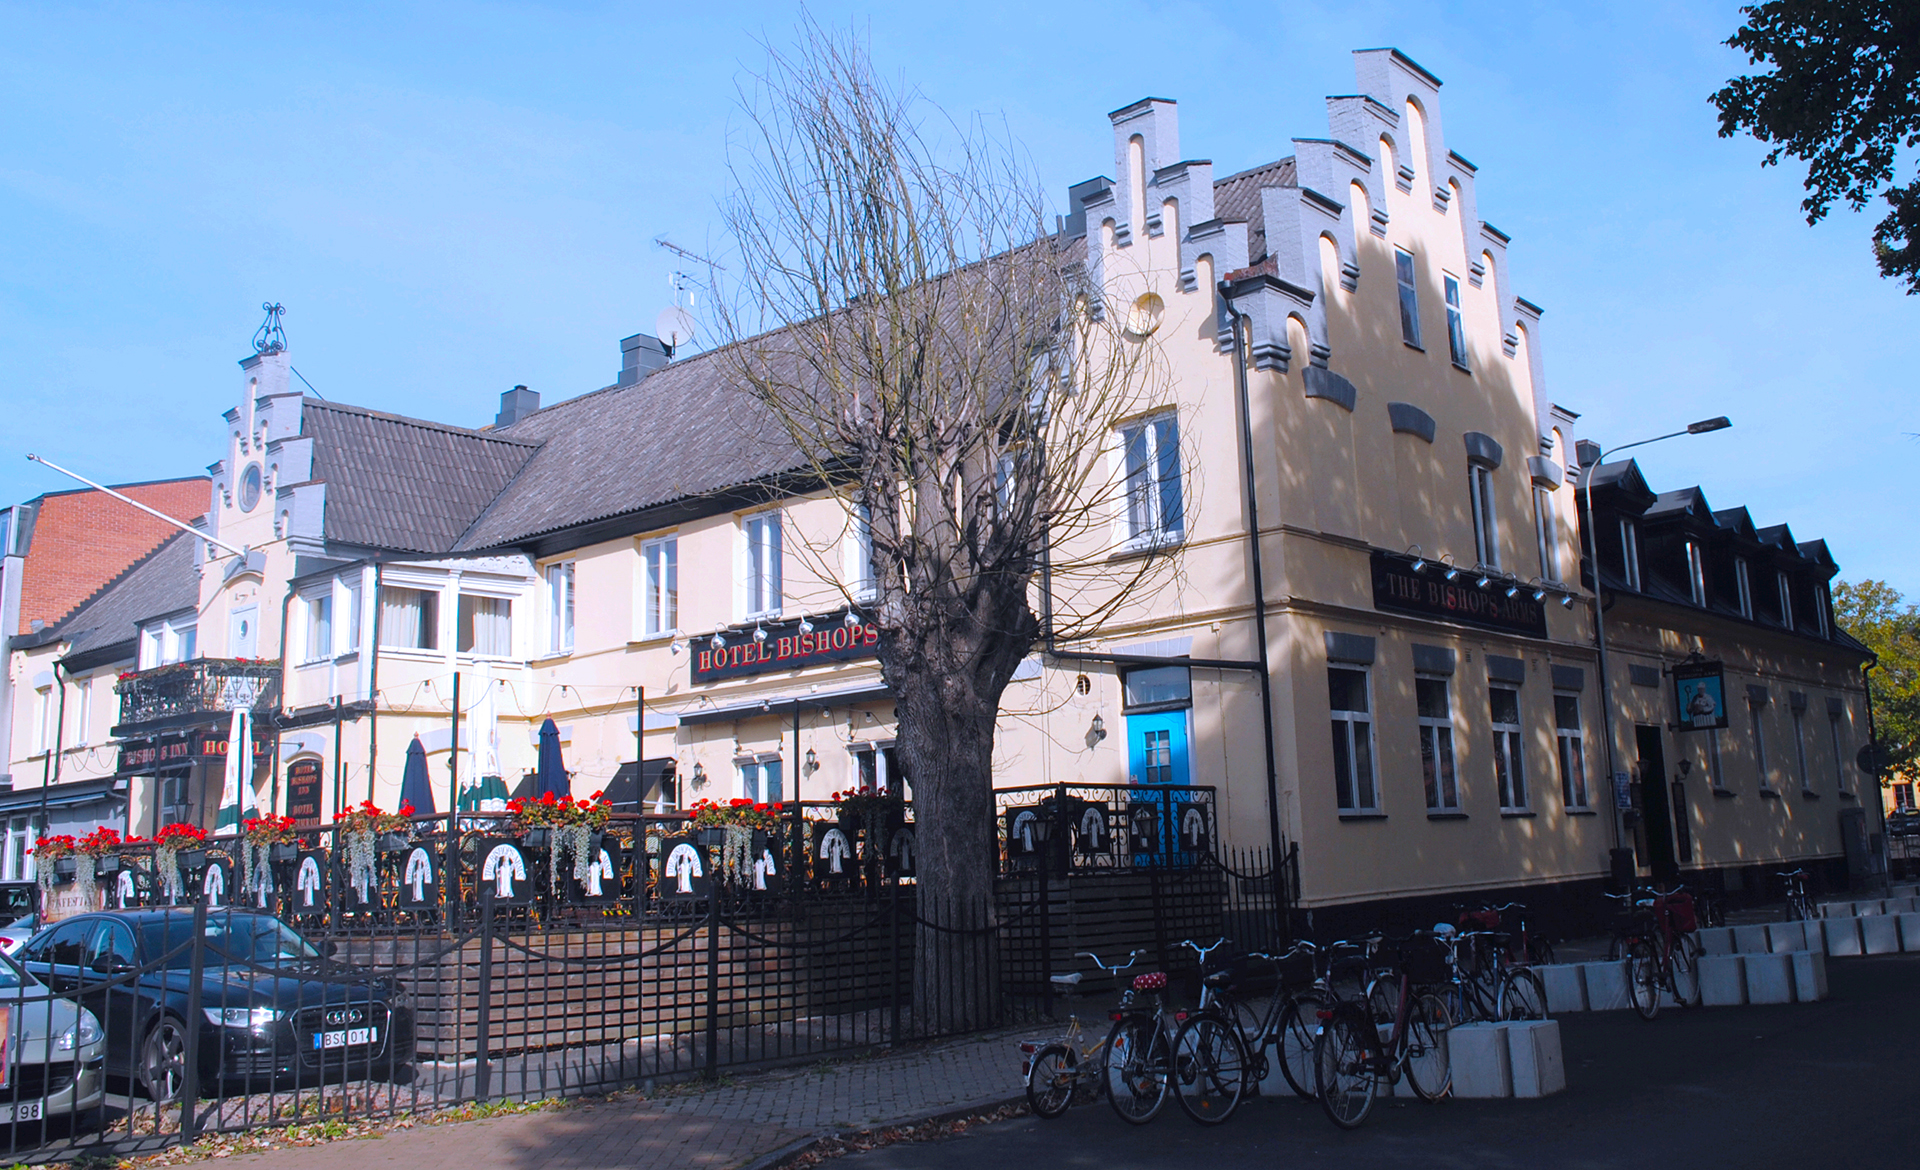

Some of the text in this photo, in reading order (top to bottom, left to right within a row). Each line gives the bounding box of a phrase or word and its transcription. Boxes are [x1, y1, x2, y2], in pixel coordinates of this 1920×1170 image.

[1387, 573, 1538, 625] THE BISHOPS ARMS
[698, 623, 879, 673] HOTEL BISHOPS
[126, 742, 189, 766] BISHOS INN
[203, 740, 264, 756] HOL
